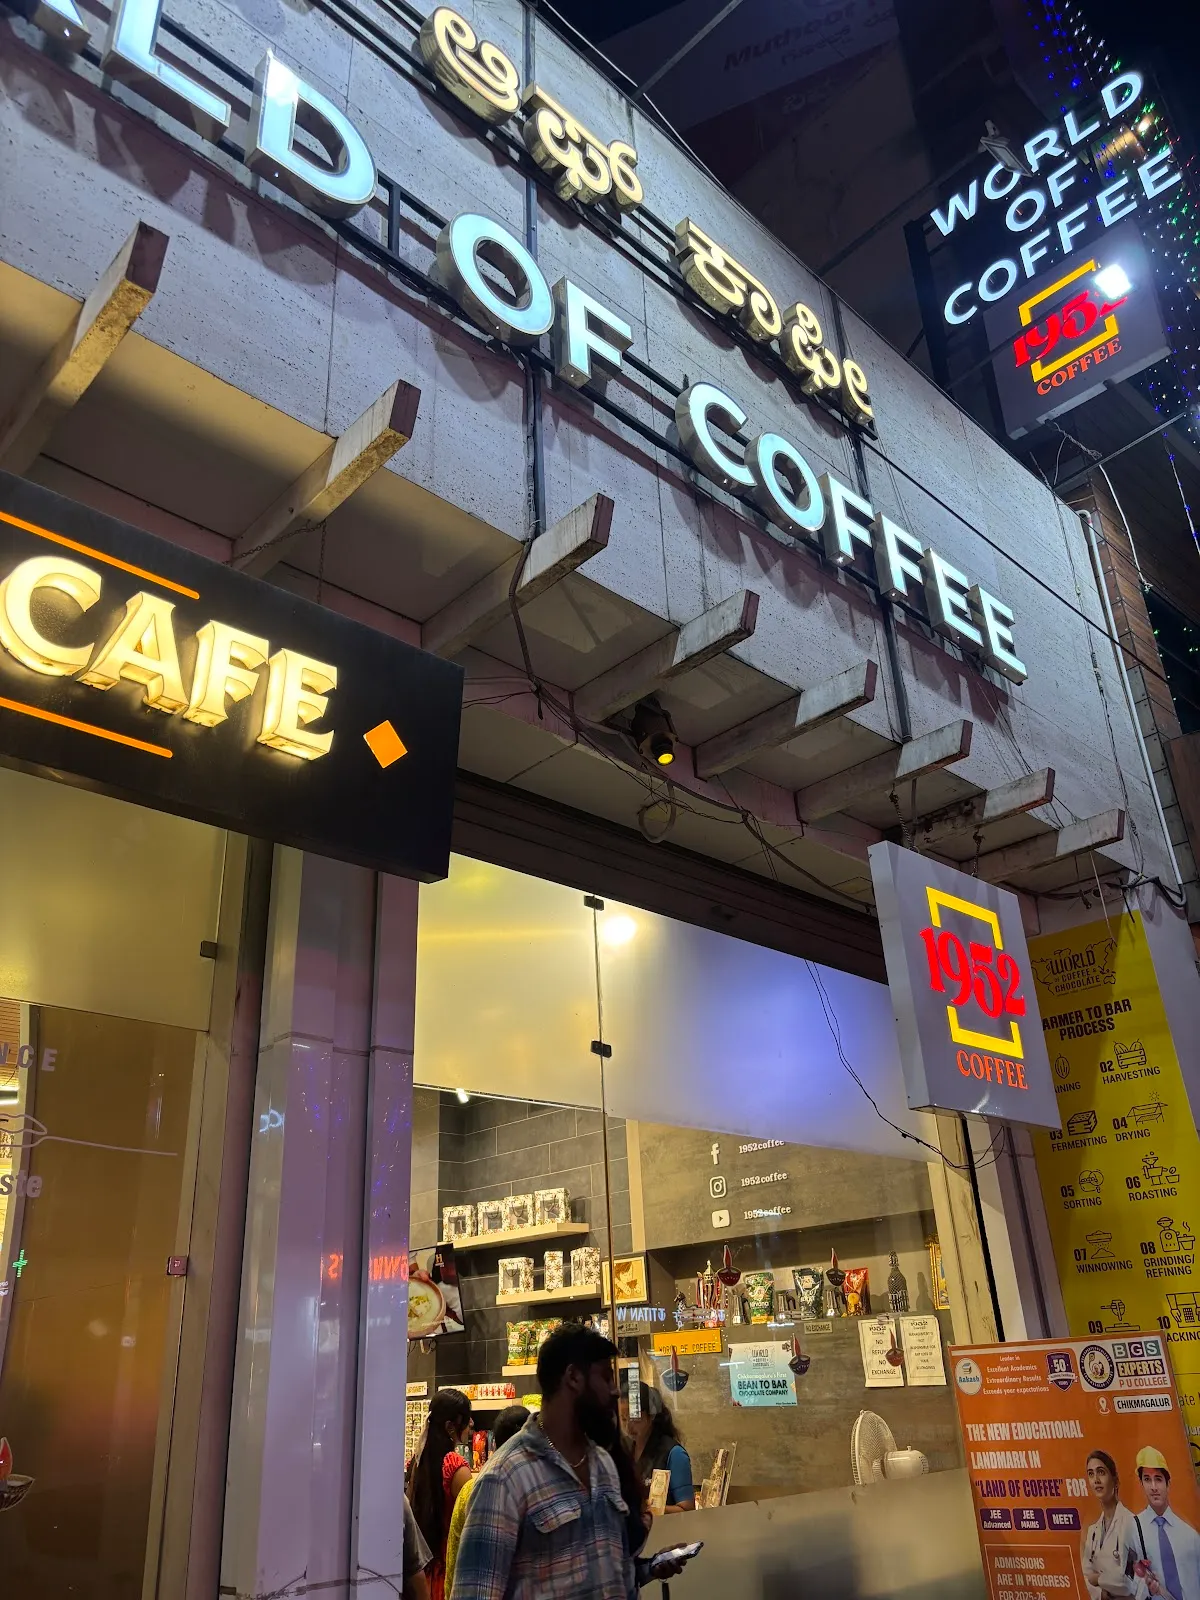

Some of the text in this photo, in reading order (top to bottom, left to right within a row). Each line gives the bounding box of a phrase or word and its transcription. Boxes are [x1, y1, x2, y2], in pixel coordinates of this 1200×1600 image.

[420, 5, 644, 213] ಆಫ್
[929, 71, 1143, 236] WORLD
[1005, 158, 1077, 232] OF
[944, 147, 1182, 325] COFFEE
[36, 0, 1028, 684] LD OF COFFEE
[1036, 337, 1122, 396] COFFEE
[0, 555, 338, 761] CAFE
[1050, 949, 1096, 975] WORLD
[919, 927, 1026, 1018] 1952
[1061, 968, 1090, 982] COFFEE
[1055, 974, 1101, 992] CHOCOLATE
[1042, 999, 1132, 1031] ARMER TO BAR
[1059, 1017, 1116, 1041] PROCESS
[957, 1050, 1029, 1090] COFFEE
[1100, 1060, 1115, 1073] 02
[1102, 1066, 1161, 1084] HARVESTING
[1112, 1117, 1128, 1130] 04
[1050, 1129, 1063, 1141] 03
[1115, 1128, 1151, 1142] DRYING
[1051, 1135, 1108, 1152] FERMENTING
[741, 1172, 788, 1187] 1952coffee
[1125, 1176, 1141, 1189] 06
[1060, 1185, 1075, 1198] 05
[1128, 1187, 1178, 1202] ROASTING
[1063, 1197, 1102, 1210] SORTING
[1074, 1248, 1087, 1262] 07
[1140, 1241, 1156, 1255] 08
[1076, 1260, 1133, 1274] WINNOWING
[1143, 1254, 1195, 1268] GRINDING/
[1145, 1266, 1192, 1279] REFINING
[1088, 1320, 1104, 1334] 09
[1157, 1315, 1171, 1330] 10
[1166, 1331, 1200, 1342] ACKIN
[1113, 1342, 1157, 1358] BGS
[1011, 1364, 1038, 1372] Academics
[1053, 1358, 1067, 1373] 50
[1117, 1360, 1163, 1376] EXPERTS
[737, 1379, 788, 1390] BEAN TO BAR
[1120, 1377, 1168, 1388] P U COLLEGE
[1116, 1397, 1170, 1410] CHIKMAGALUR
[966, 1420, 1084, 1441] THE NEW EDUCATIONAL
[970, 1450, 1041, 1470] LANDMARK IN
[1008, 1480, 1021, 1498] OF
[1065, 1478, 1089, 1497] FOR
[989, 1509, 1002, 1519] JEE
[1022, 1509, 1035, 1519] JEE
[1052, 1513, 1074, 1525] NEET
[983, 1520, 1011, 1529] Advanced
[1020, 1520, 1040, 1529] MAINS
[994, 1556, 1045, 1570] ADMISSIONS
[997, 1573, 1071, 1588] ARE IN PROGRESS
[998, 1590, 1014, 1600] FOR
